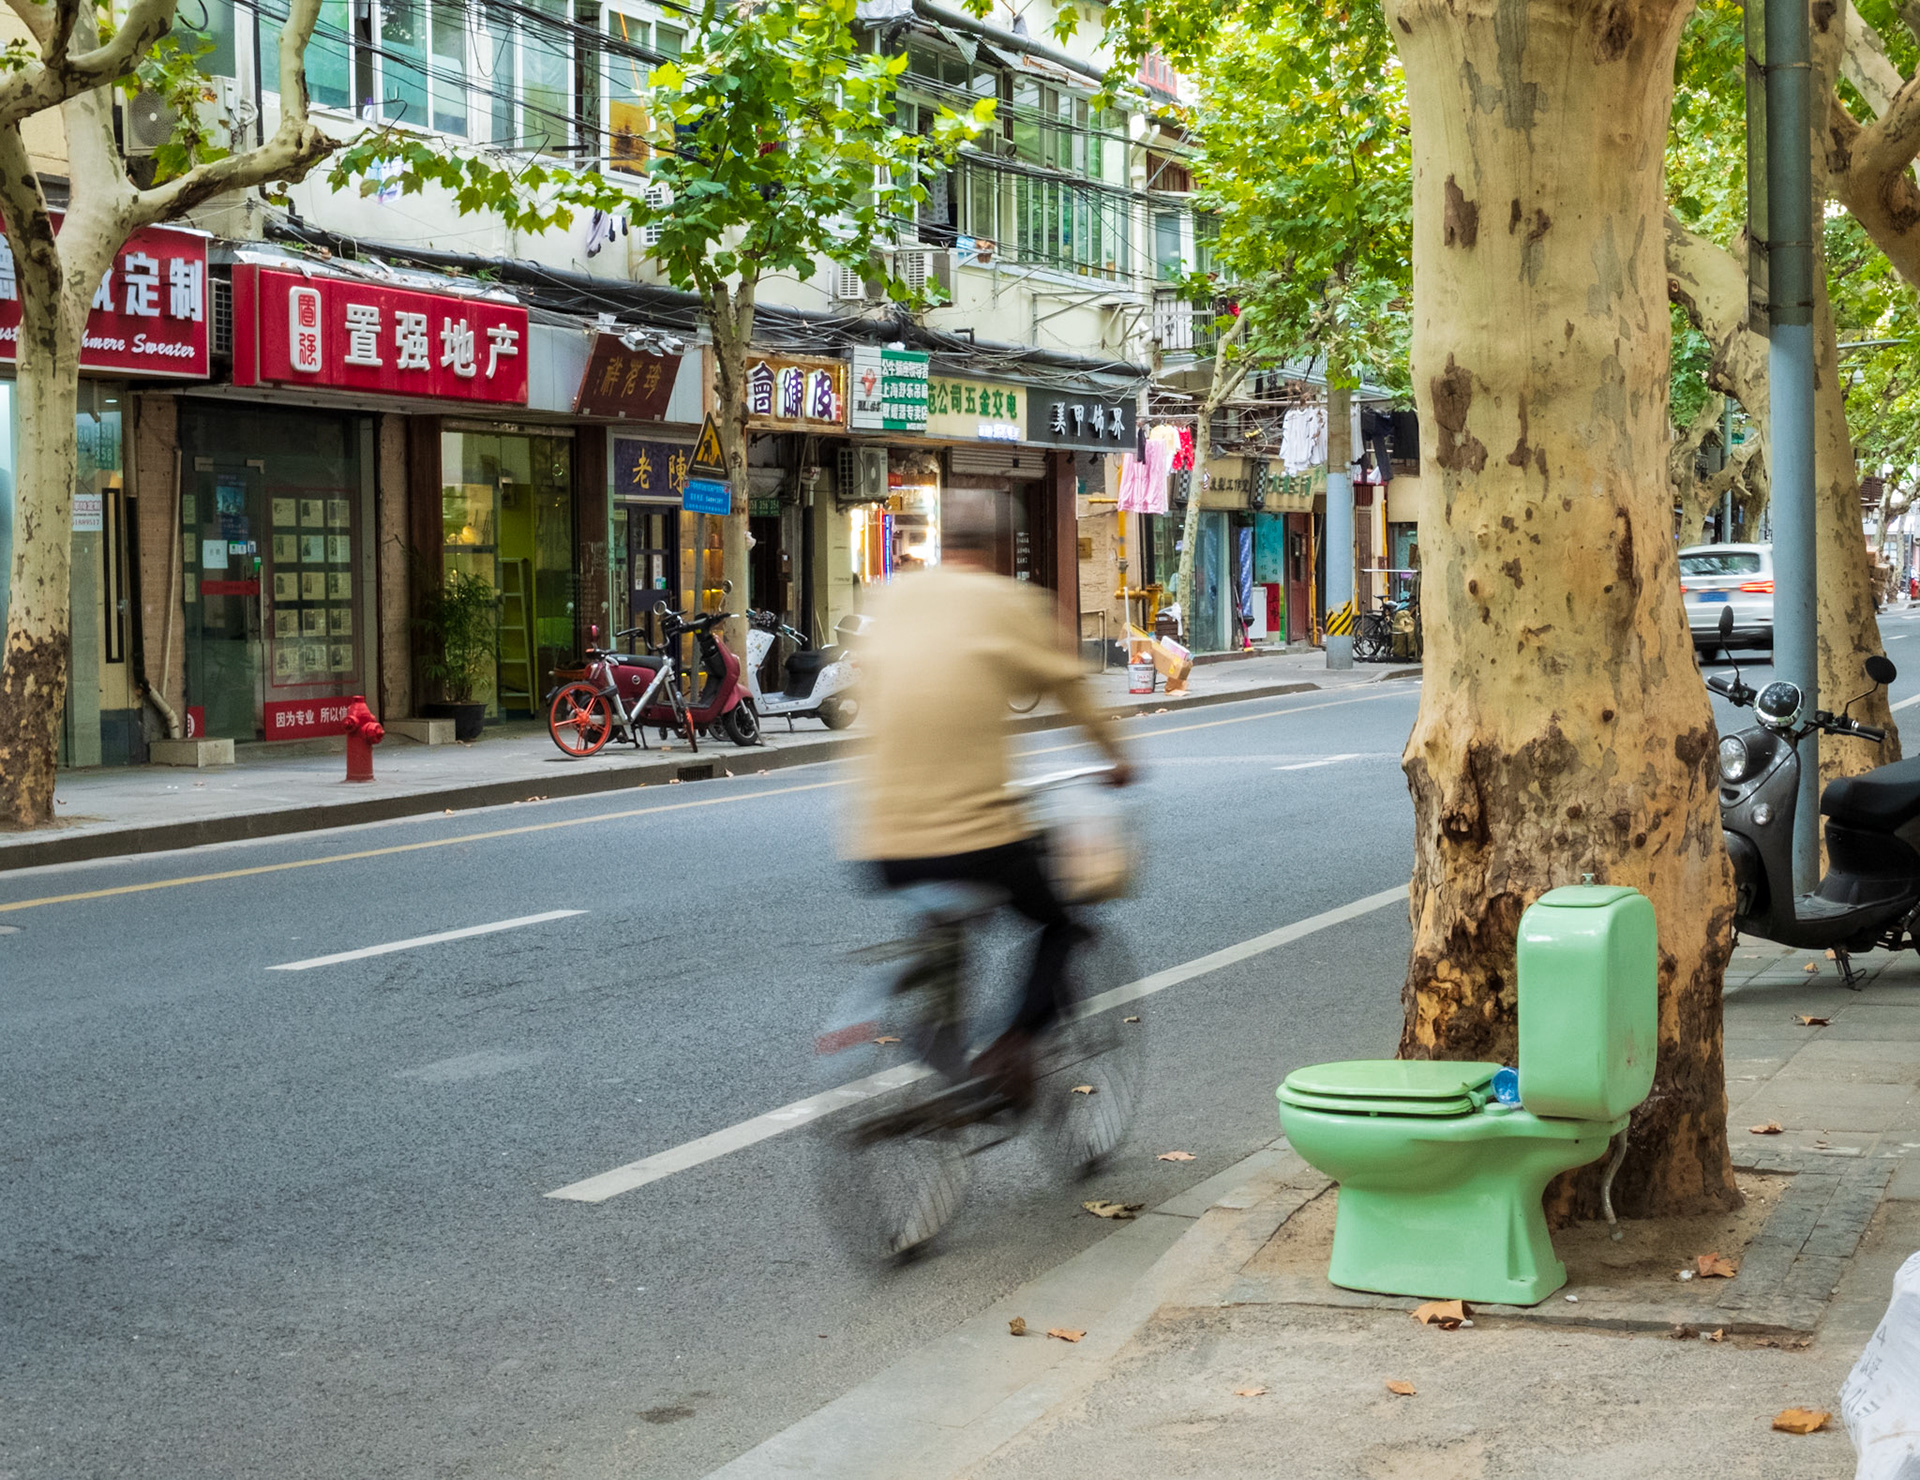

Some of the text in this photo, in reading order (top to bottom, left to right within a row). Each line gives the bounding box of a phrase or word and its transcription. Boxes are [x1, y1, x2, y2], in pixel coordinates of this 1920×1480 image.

[131, 333, 195, 358] Sweater
[344, 303, 519, 379] 置强地产
[275, 709, 315, 728] 因为专业
